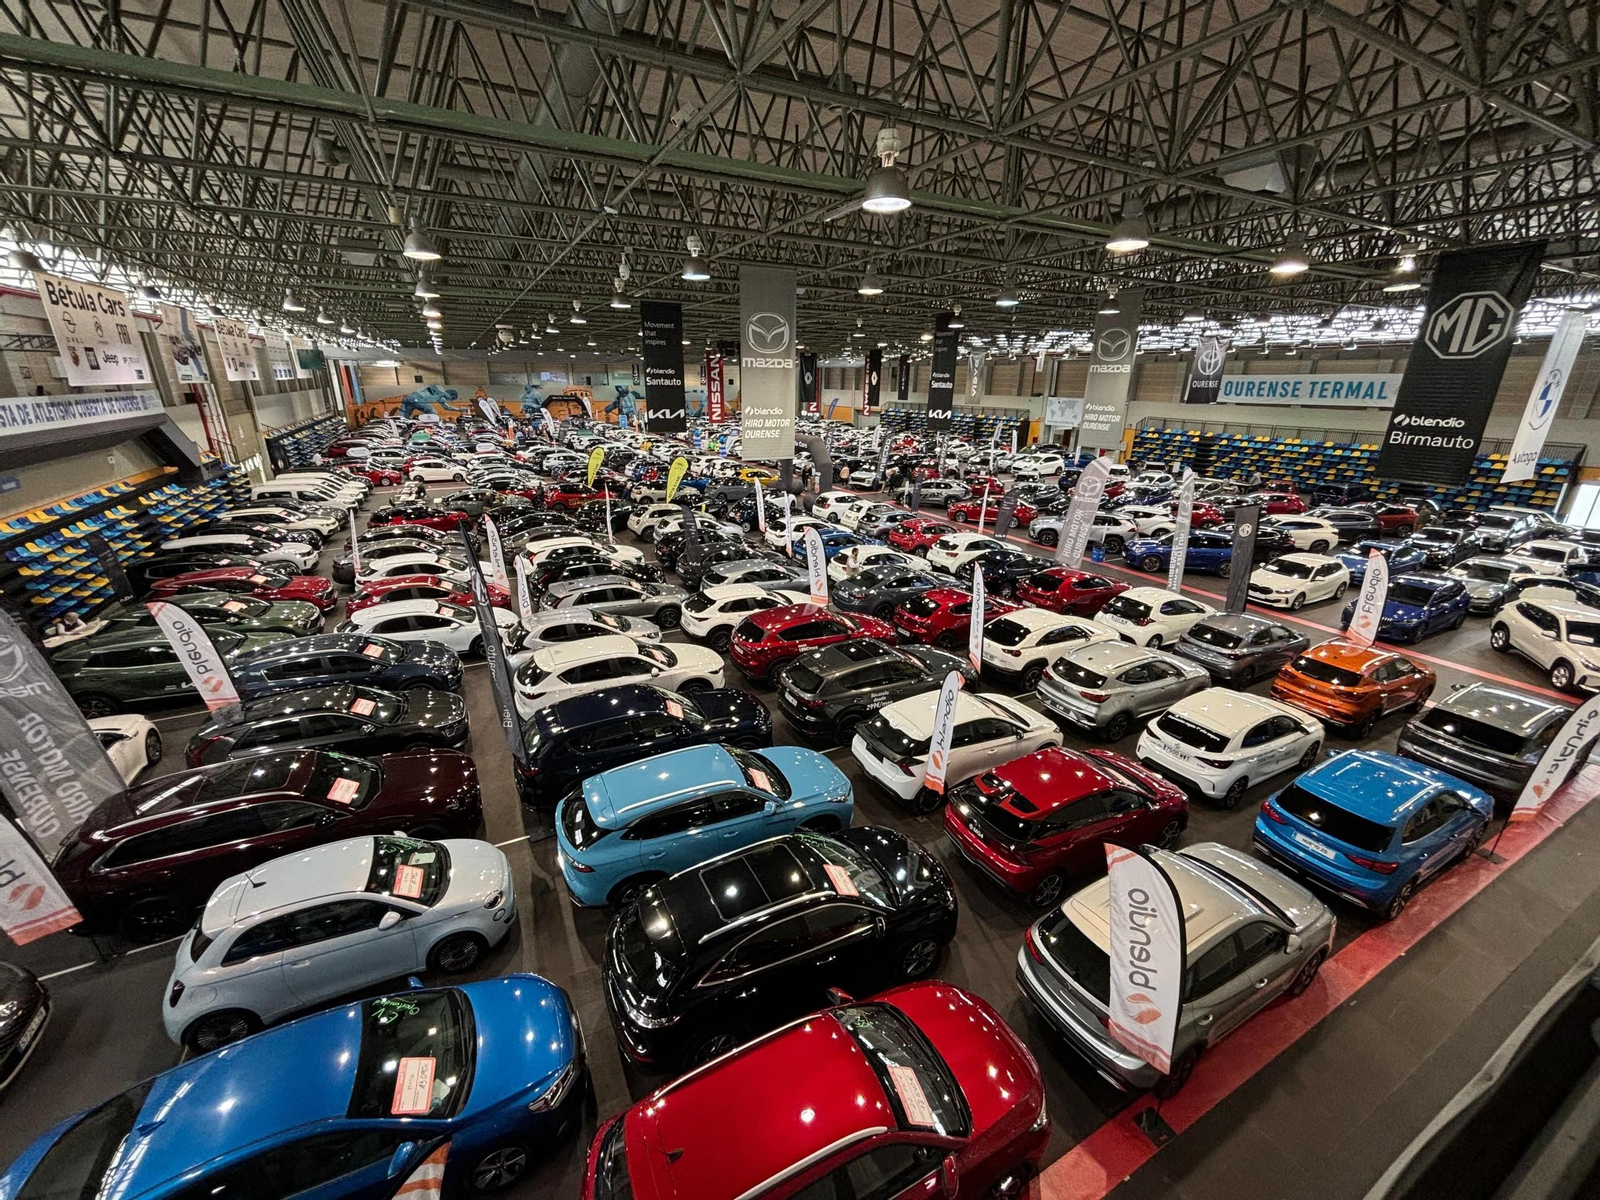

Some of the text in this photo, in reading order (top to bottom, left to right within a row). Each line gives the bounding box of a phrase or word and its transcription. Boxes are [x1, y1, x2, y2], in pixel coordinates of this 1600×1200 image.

[44, 280, 125, 317] Bétula Cars
[644, 321, 675, 329] Movement
[1433, 298, 1505, 353] MG
[103, 351, 119, 366] Jeep
[646, 377, 681, 386] Santauto
[931, 380, 953, 389] Santauto
[1192, 379, 1219, 389] OURENSE
[711, 354, 722, 421] NISSAN
[1223, 380, 1388, 399] OURENSE TERMAL
[16, 402, 33, 425] DE
[31, 399, 77, 423] ATLETISMO
[754, 407, 783, 415] blendio
[1093, 404, 1116, 412] blendio
[648, 409, 686, 419] KIA
[928, 408, 952, 419] KIA
[745, 419, 790, 428] HIRO MOTOR
[1097, 415, 1121, 423] MOTOR
[1410, 416, 1465, 428] blendio
[1082, 421, 1111, 431] OURENSE
[745, 430, 780, 438] OURENSE
[1389, 431, 1474, 449] Birmauto
[1063, 508, 1083, 557] HIRO MOTOR
[1073, 522, 1090, 559] OURENSE
